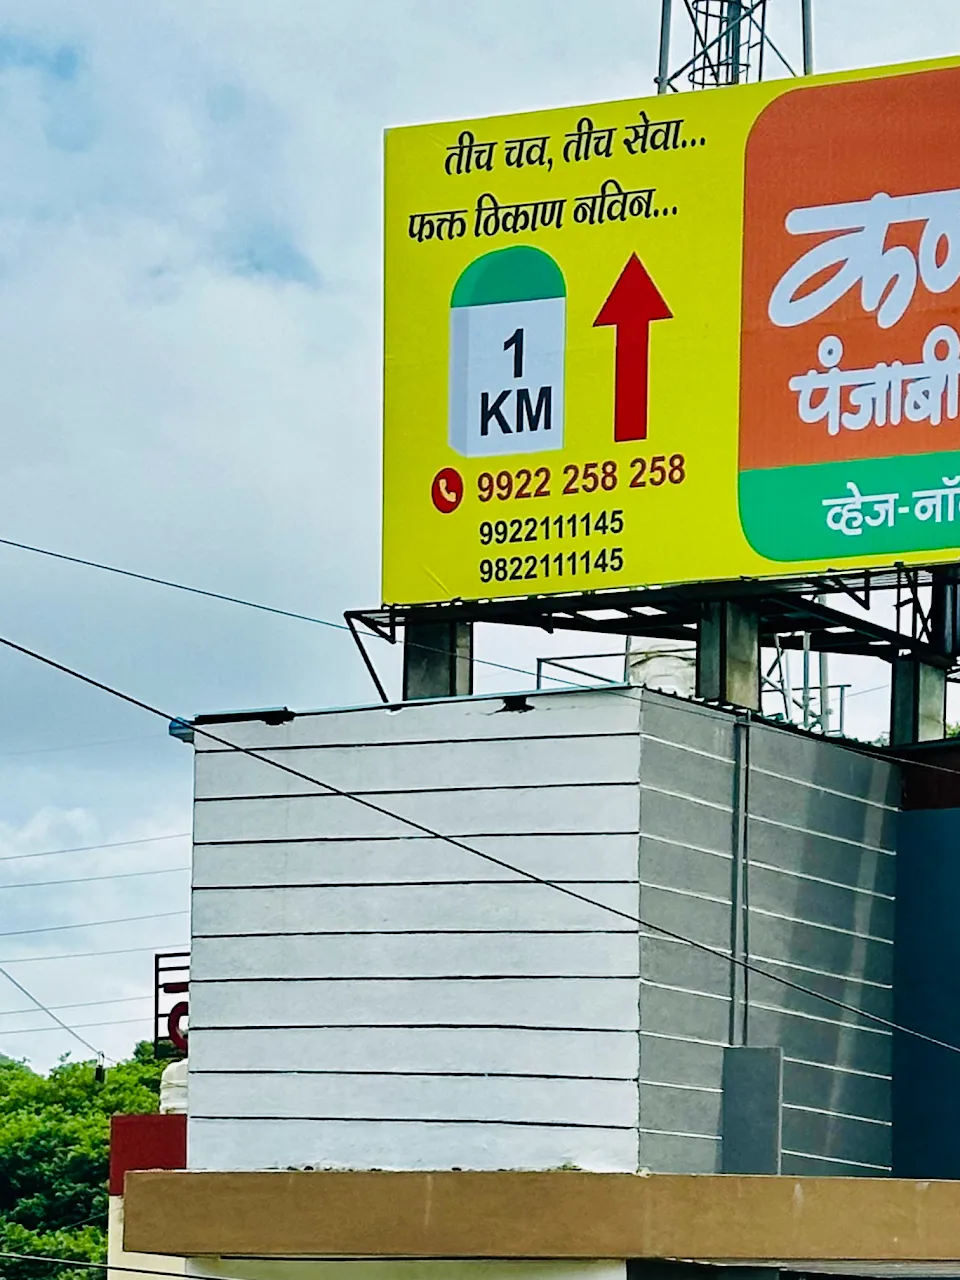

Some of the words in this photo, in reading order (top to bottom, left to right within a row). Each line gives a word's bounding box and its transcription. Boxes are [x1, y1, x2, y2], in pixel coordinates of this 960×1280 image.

[445, 130, 498, 176] तीच
[505, 136, 554, 173] चव,
[563, 117, 617, 162] तीच
[624, 110, 707, 154] सेवा...
[408, 209, 467, 244] फक्त
[474, 192, 567, 238] ठिकाण
[503, 328, 524, 379] 1
[480, 386, 552, 437] KM
[477, 467, 551, 502] 9922
[562, 459, 618, 497] 258
[629, 453, 686, 489] 258
[479, 509, 624, 546] 9922111145
[479, 547, 624, 584] 9822111145
